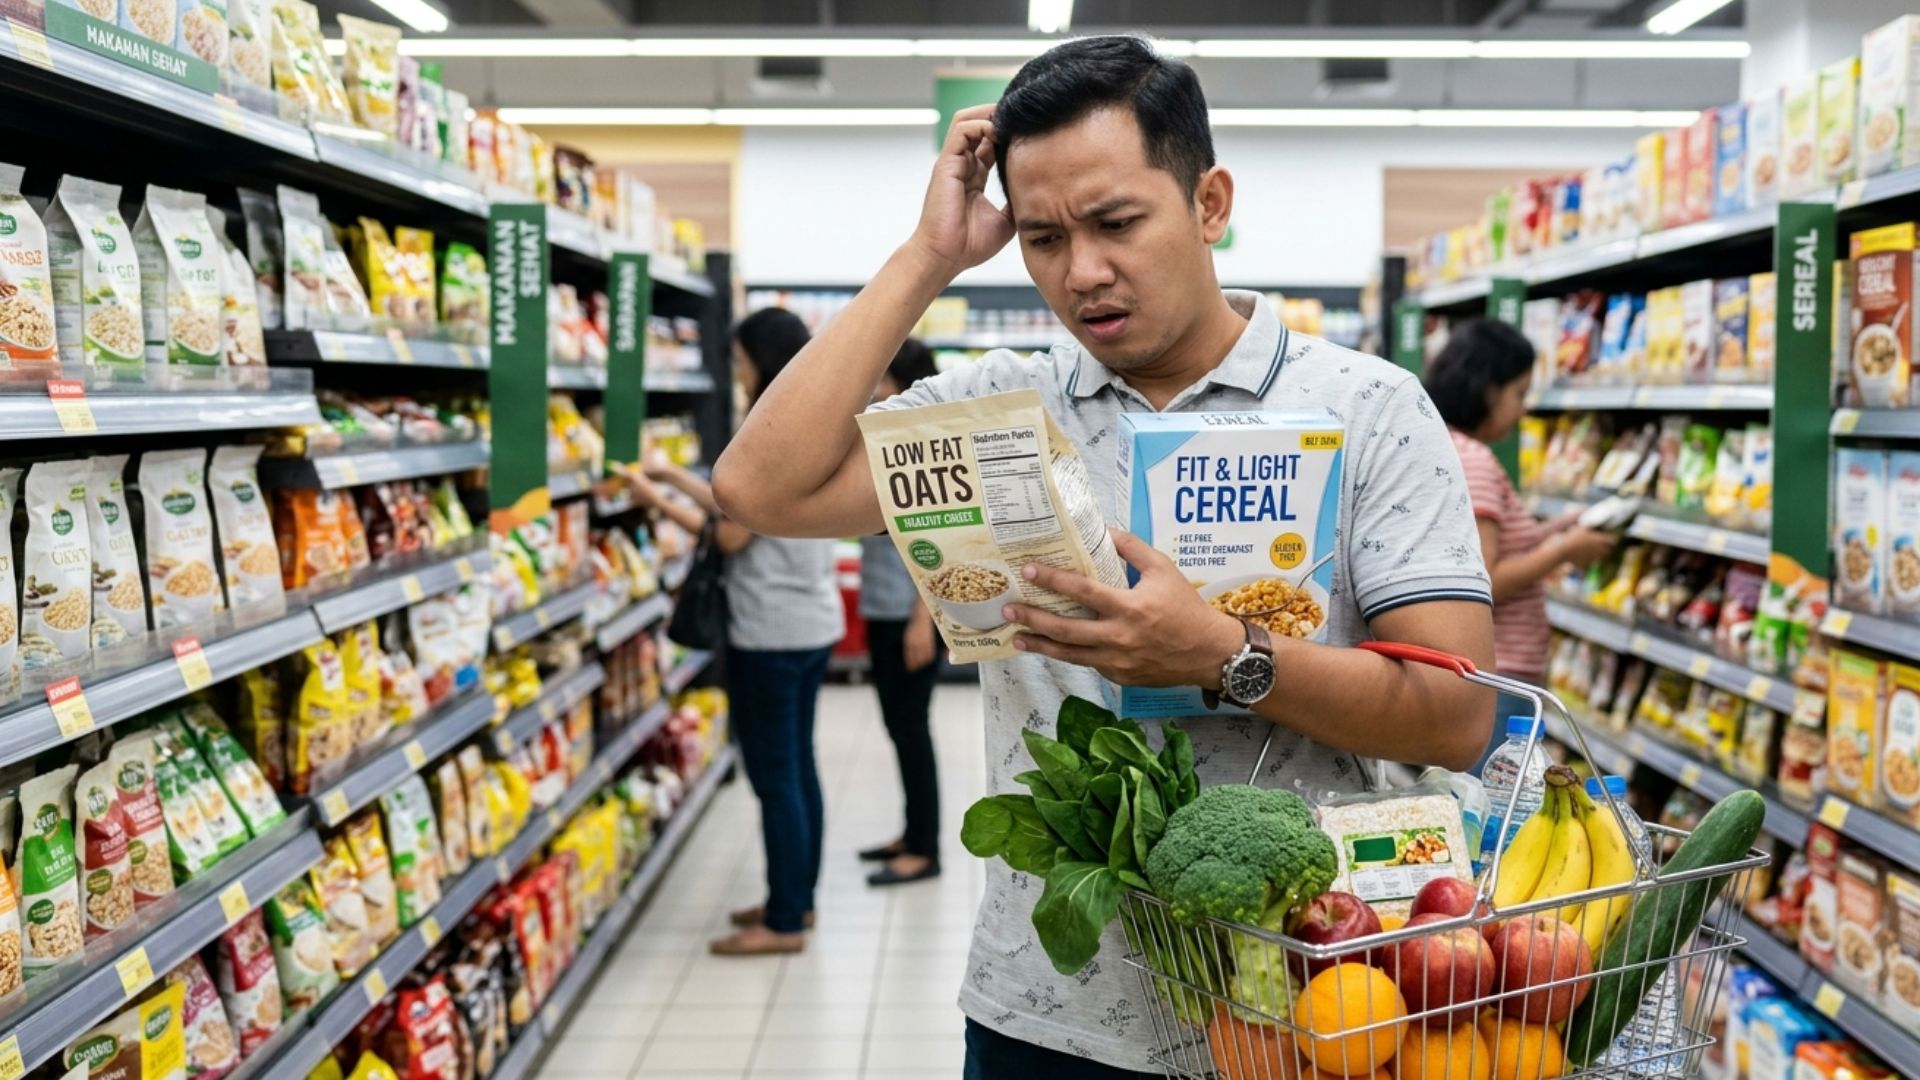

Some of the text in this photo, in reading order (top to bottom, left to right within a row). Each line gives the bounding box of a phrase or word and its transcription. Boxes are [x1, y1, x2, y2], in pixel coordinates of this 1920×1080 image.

[495, 220, 517, 344] MAKANAN
[519, 220, 541, 298] SEHAT
[1793, 228, 1818, 332] SEREAL
[882, 441, 924, 469] LOW
[929, 436, 963, 463] FAT
[1176, 454, 1301, 482] FIT & LIGHT
[888, 463, 973, 509] OATS
[1175, 484, 1296, 524] CEREAL
